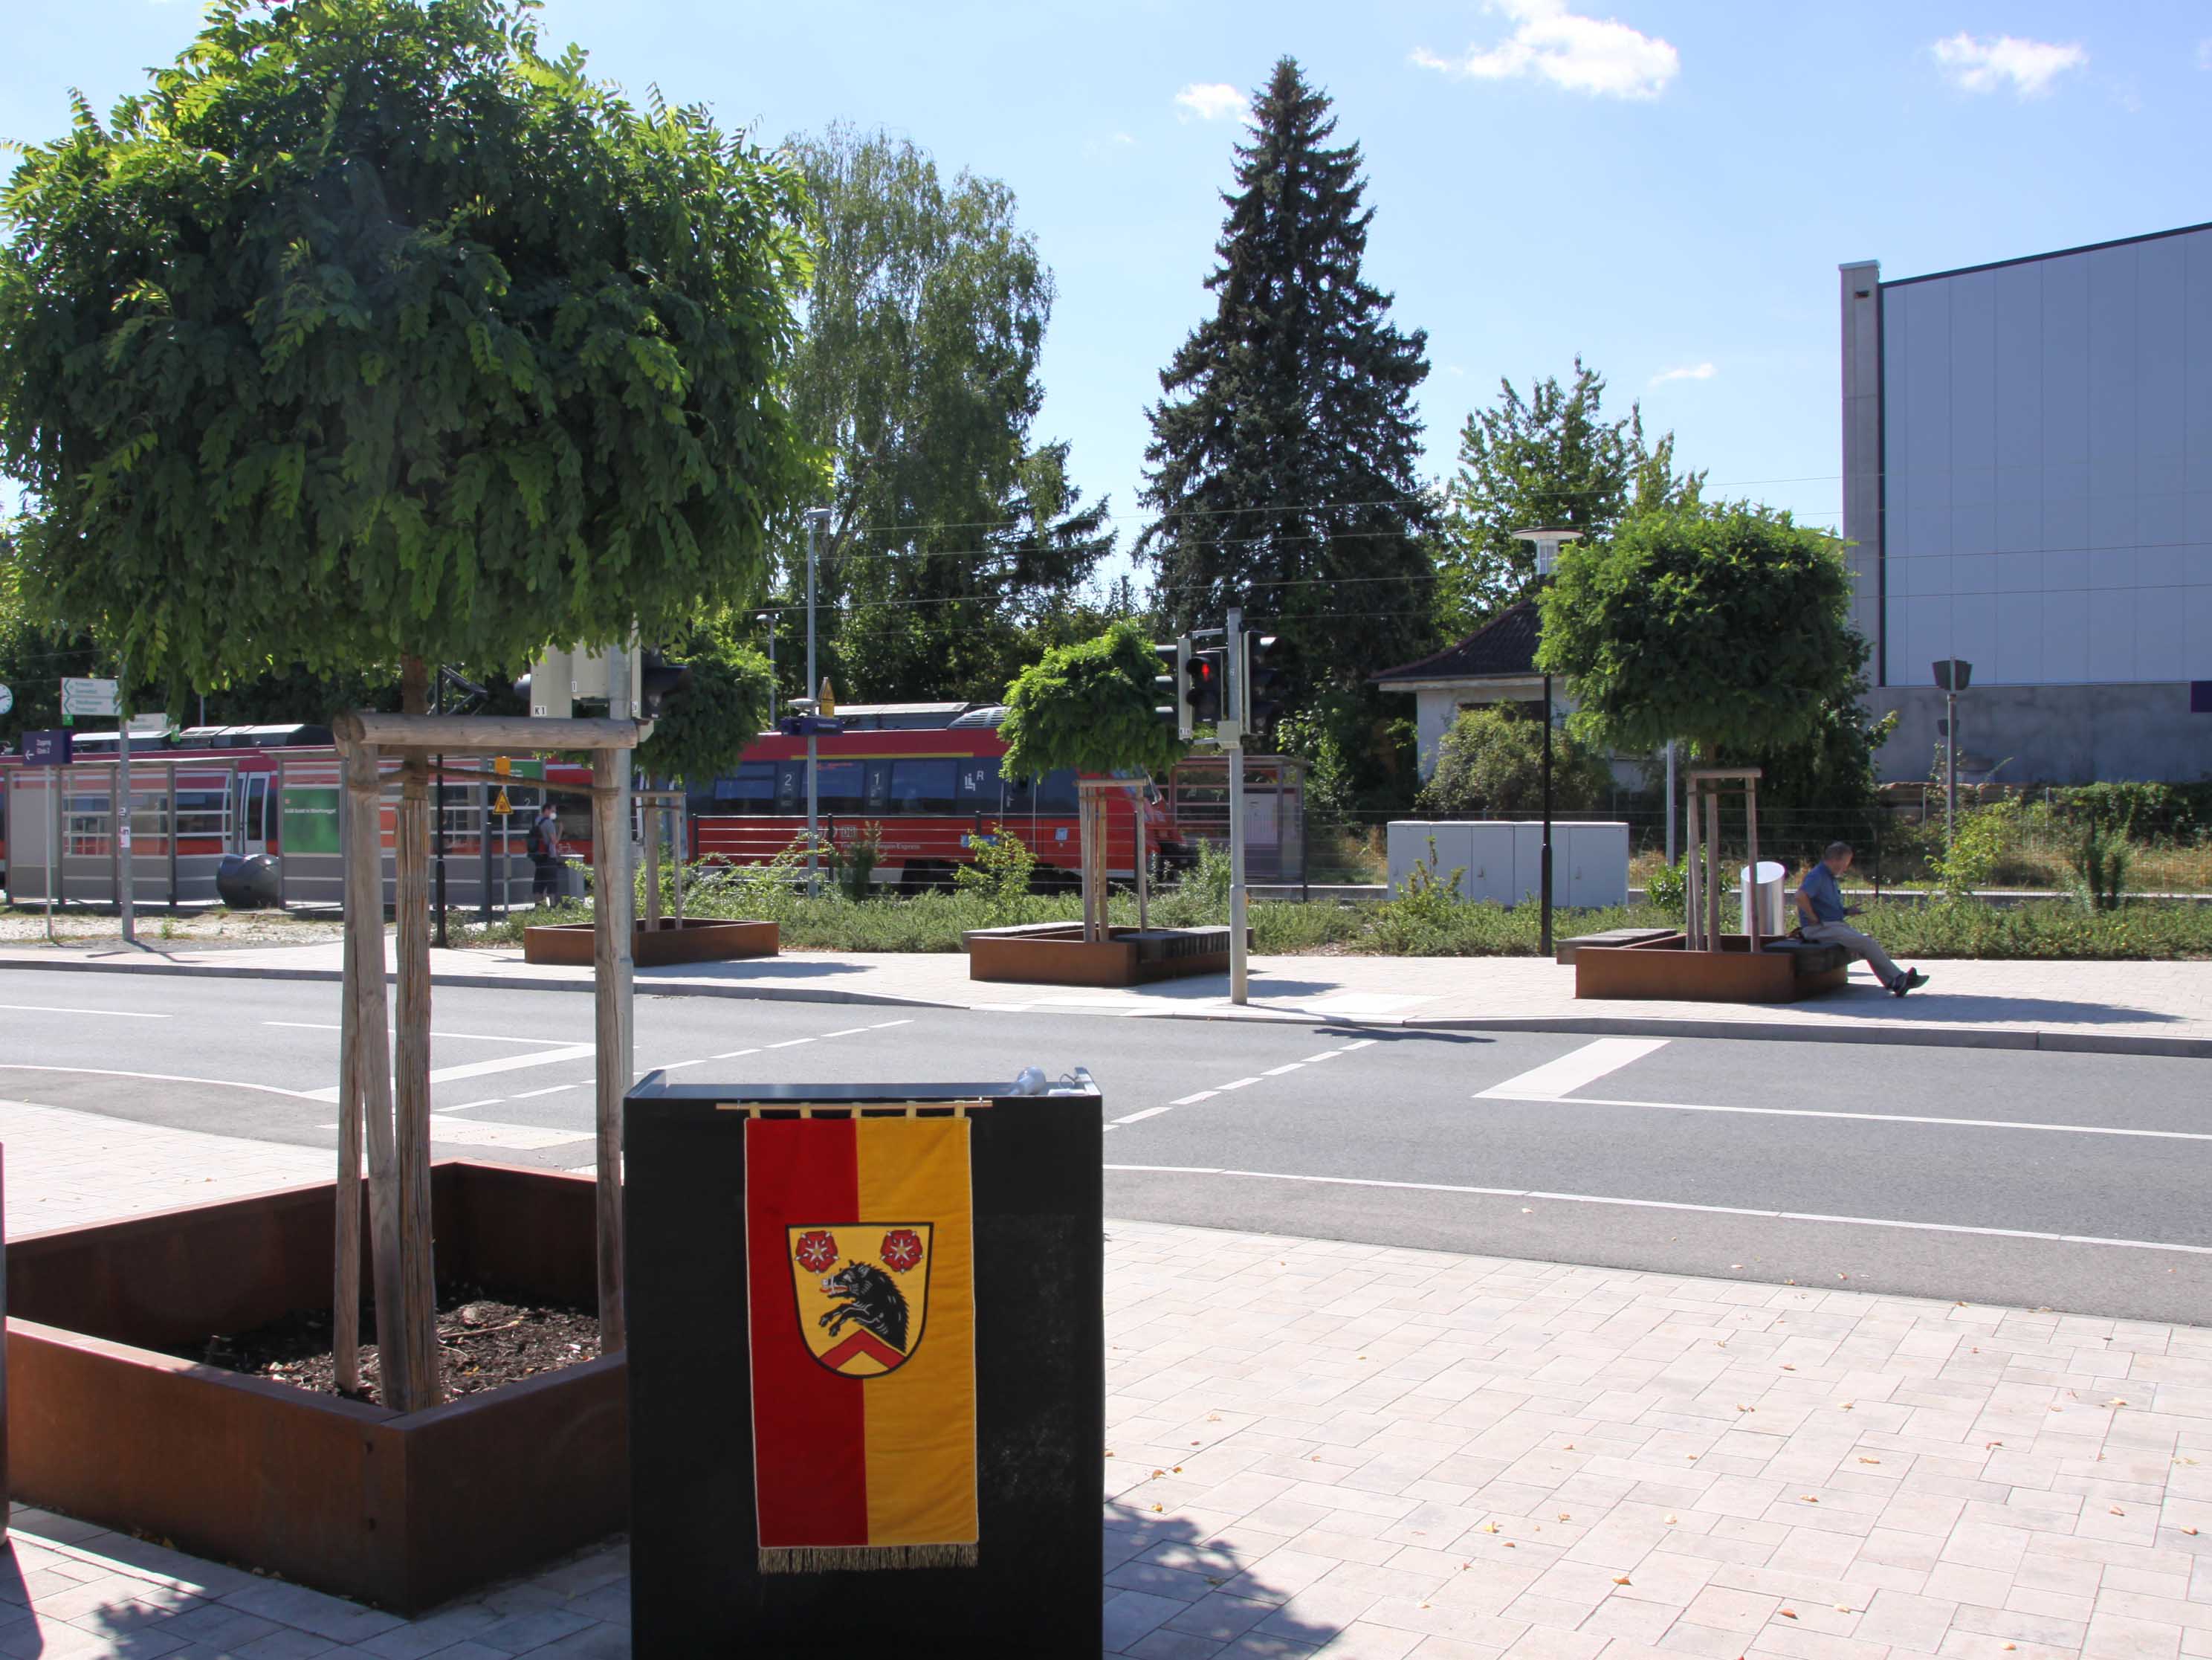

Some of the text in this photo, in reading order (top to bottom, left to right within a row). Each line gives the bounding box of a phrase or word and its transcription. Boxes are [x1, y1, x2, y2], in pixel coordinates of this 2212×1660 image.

[784, 773, 792, 787] 2
[874, 772, 879, 786] 1
[977, 770, 984, 781] R
